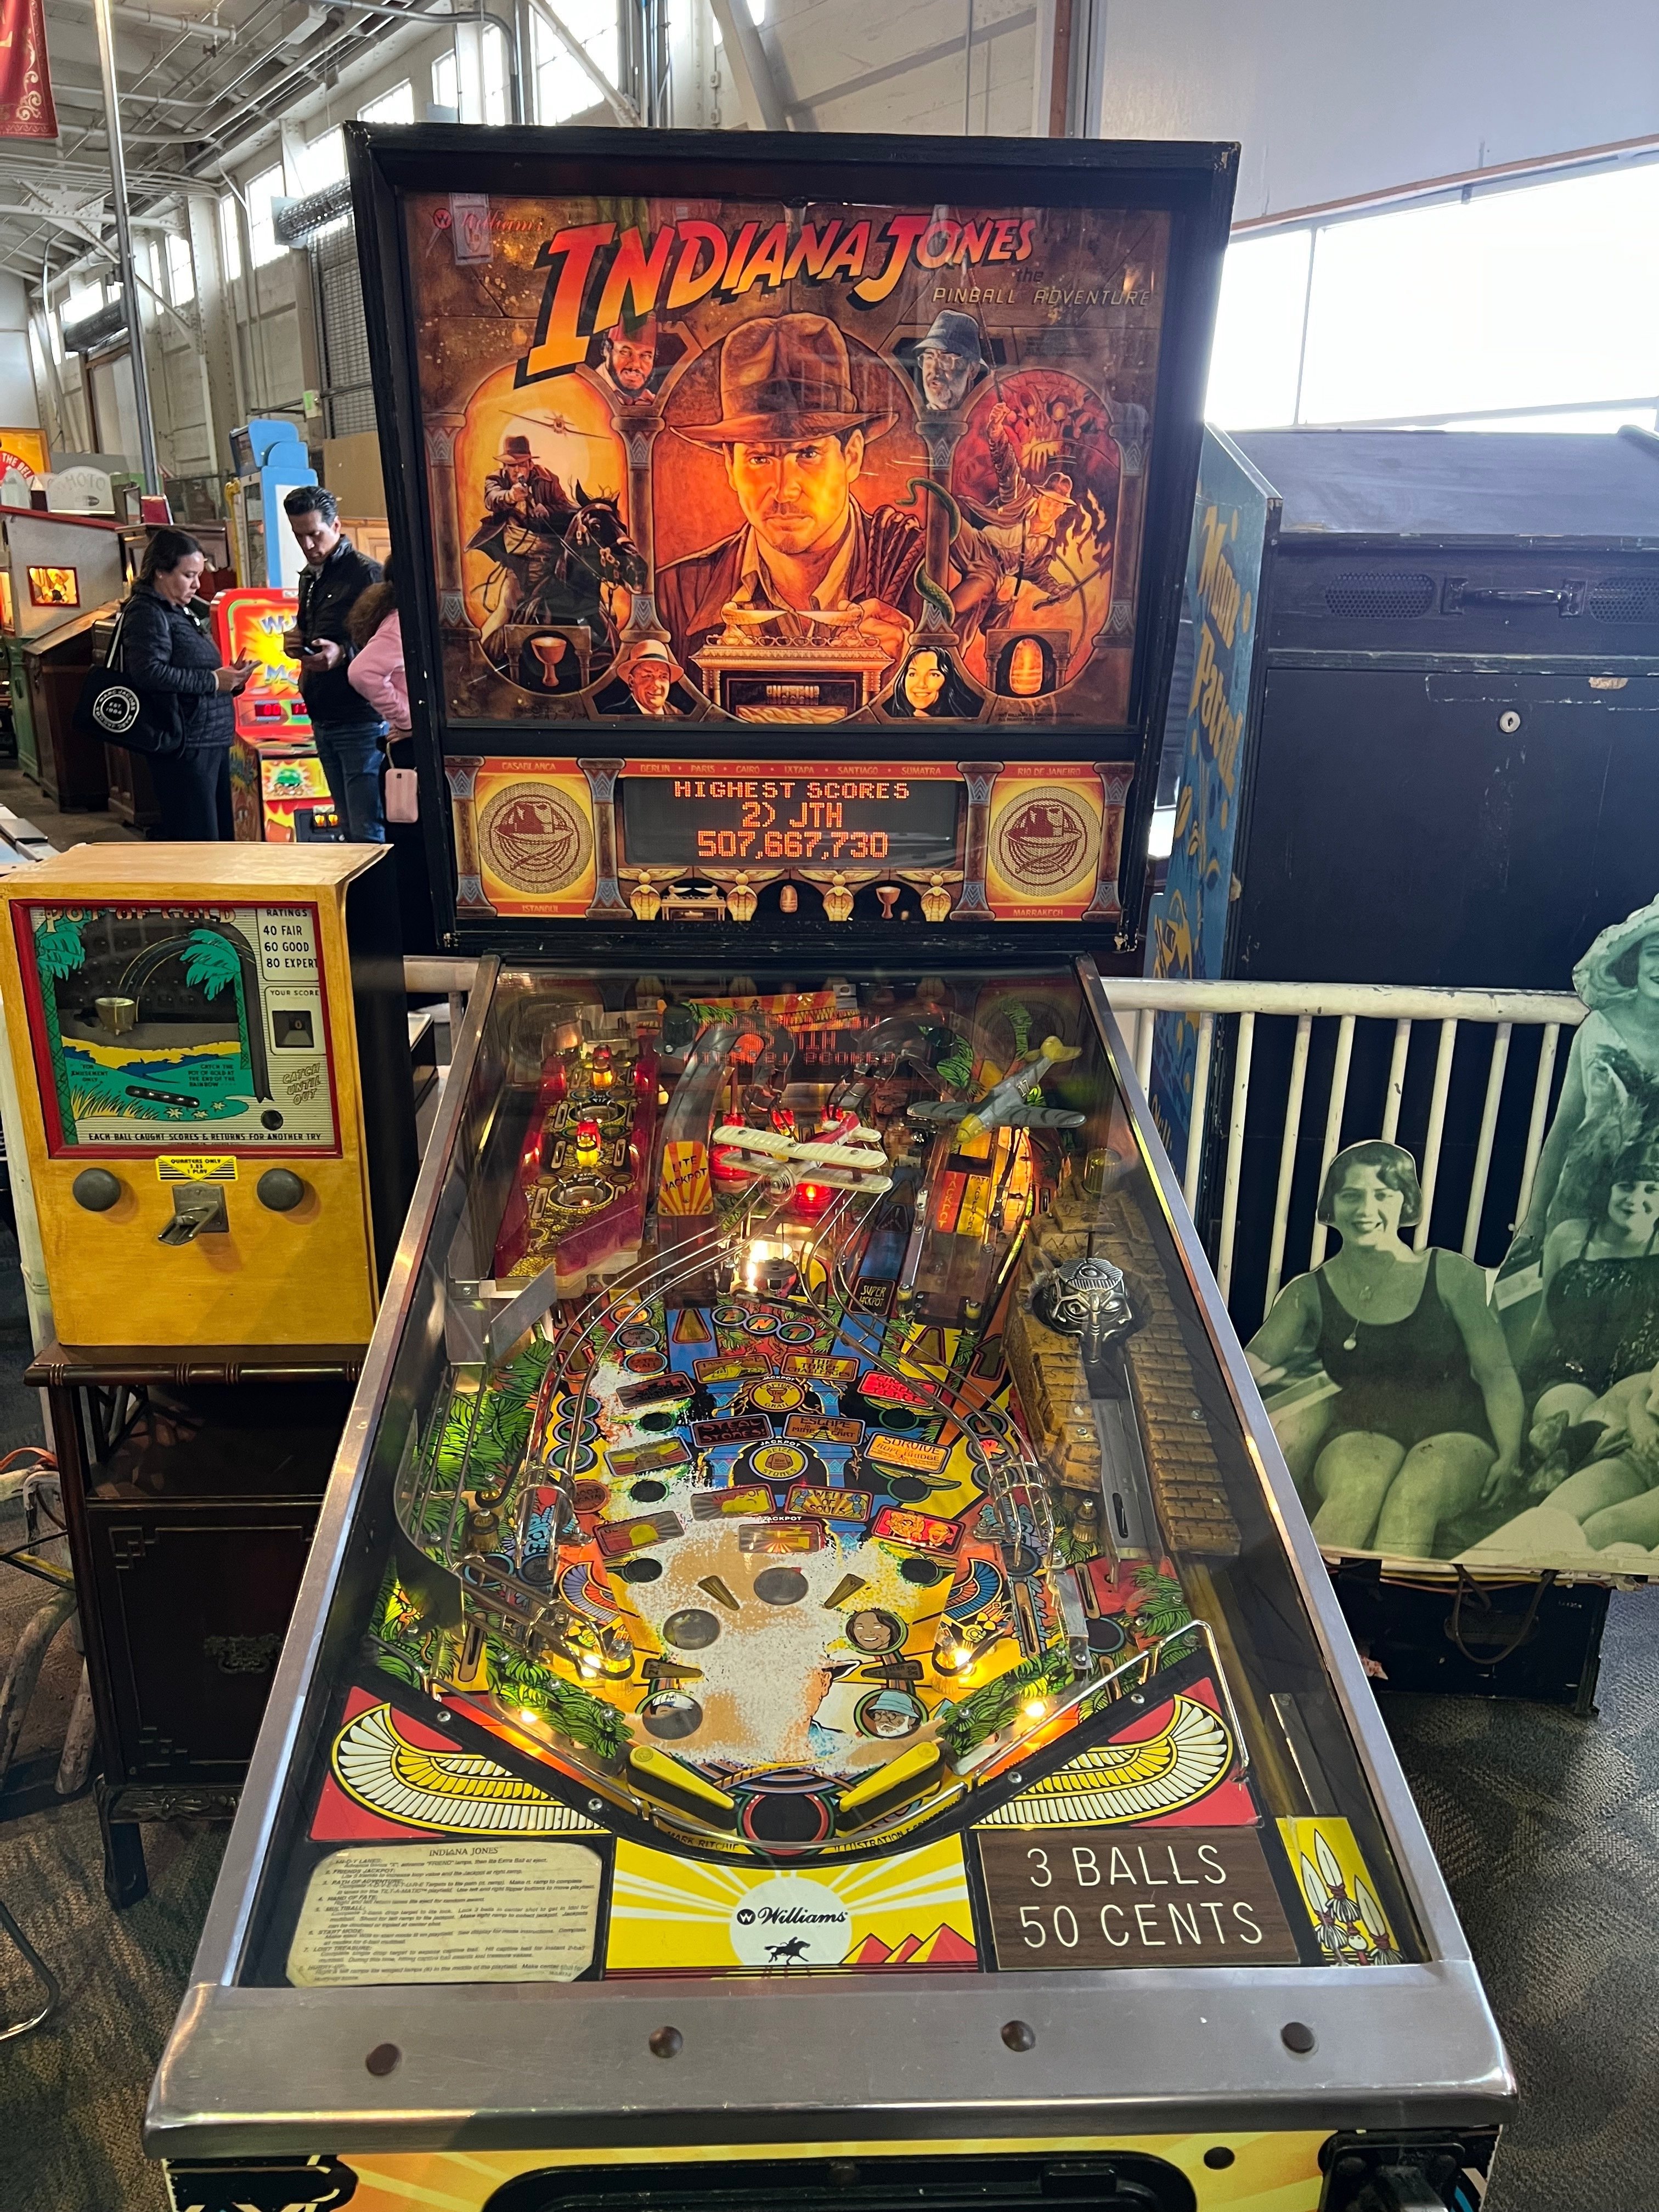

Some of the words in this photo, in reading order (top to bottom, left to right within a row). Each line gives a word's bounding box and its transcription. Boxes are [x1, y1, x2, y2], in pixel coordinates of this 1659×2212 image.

[1017, 269, 1042, 283] the
[527, 215, 870, 376] INDIANA
[860, 214, 1036, 304] JONES
[933, 288, 1015, 303] PINBALL
[1034, 290, 1151, 305] ADVENTURE
[2, 453, 18, 466] THE
[1198, 505, 1240, 648] Moon
[1188, 622, 1243, 796] Patrol
[501, 762, 556, 771] CASABLANCA
[640, 764, 670, 772] BERLIN
[691, 765, 715, 773] PARIS
[785, 766, 814, 774] IXTAPA
[837, 766, 878, 775] SANTIAGO
[901, 767, 941, 775] SUMATRA
[1034, 768, 1044, 776] DE
[1046, 768, 1081, 776] JANEIRO
[674, 781, 795, 798] HIGHEST
[807, 782, 910, 799] SCORES
[741, 802, 776, 828] 2)
[789, 803, 843, 828] JTH
[698, 831, 889, 860] 507,667,730
[267, 909, 307, 917] RATINGS
[522, 905, 560, 913] ISTANBUL
[263, 926, 277, 935] 40
[281, 926, 302, 935] FAIR
[264, 942, 278, 952] 60
[283, 942, 309, 952] GOOD
[267, 958, 280, 968] 80
[285, 958, 319, 968] EXPERT
[283, 1063, 320, 1084] CATCH
[287, 1075, 321, 1095] UNTIL
[1017, 1078, 1031, 1097] 17
[293, 1088, 318, 1105] OUT
[673, 1155, 697, 1172] LITE
[662, 1167, 708, 1192] JACKPOT
[862, 1285, 887, 1297] SUPER
[749, 1319, 774, 1330] N
[788, 1327, 806, 1339] T
[787, 1366, 850, 1378] CHALLENGES
[802, 1363, 840, 1372] THREE
[800, 1417, 851, 1429] ESCAPE
[883, 1436, 940, 1455] SURVIVE
[762, 1467, 797, 1476] STONES
[814, 1489, 846, 1500] WELL
[809, 1504, 845, 1515] SOULS
[429, 1848, 467, 1857] INDIANA
[470, 1847, 498, 1855] JONES
[1026, 1848, 1052, 1888] 3
[1072, 1844, 1227, 1887] BALLS
[757, 1906, 849, 1925] Williams
[1019, 1905, 1079, 1948] 50
[1100, 1901, 1263, 1947] CENTS
